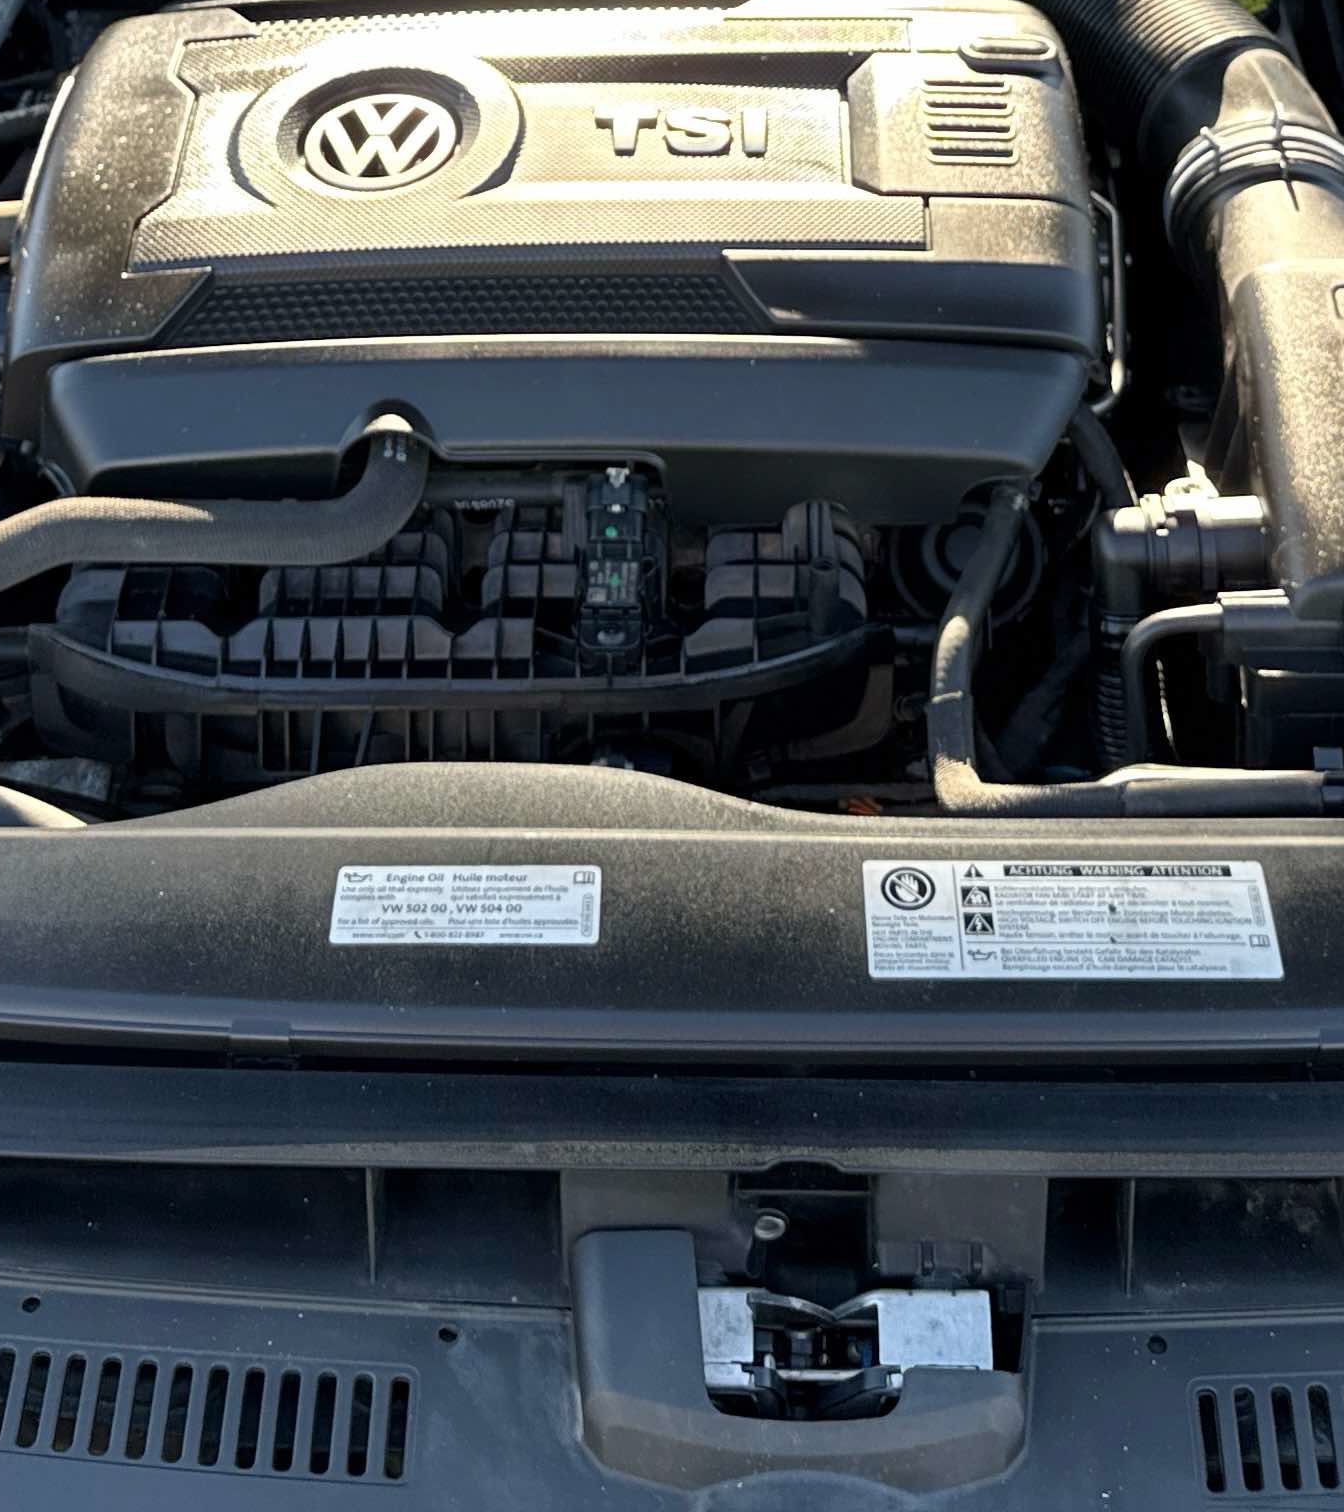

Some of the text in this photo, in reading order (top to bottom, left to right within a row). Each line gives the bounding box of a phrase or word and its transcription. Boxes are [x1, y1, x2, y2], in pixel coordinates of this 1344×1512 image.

[595, 105, 768, 156] TSI
[304, 90, 458, 192] VW
[1008, 865, 1223, 876] ACHTUNG WARNING ATTENTION
[386, 872, 445, 885] Engine Oil
[452, 872, 528, 883] Huile moteur
[382, 903, 404, 913] VW
[406, 903, 428, 913] 502
[431, 903, 448, 913] 00
[456, 903, 478, 913] VW
[480, 903, 503, 913] 504
[505, 903, 523, 913] 00
